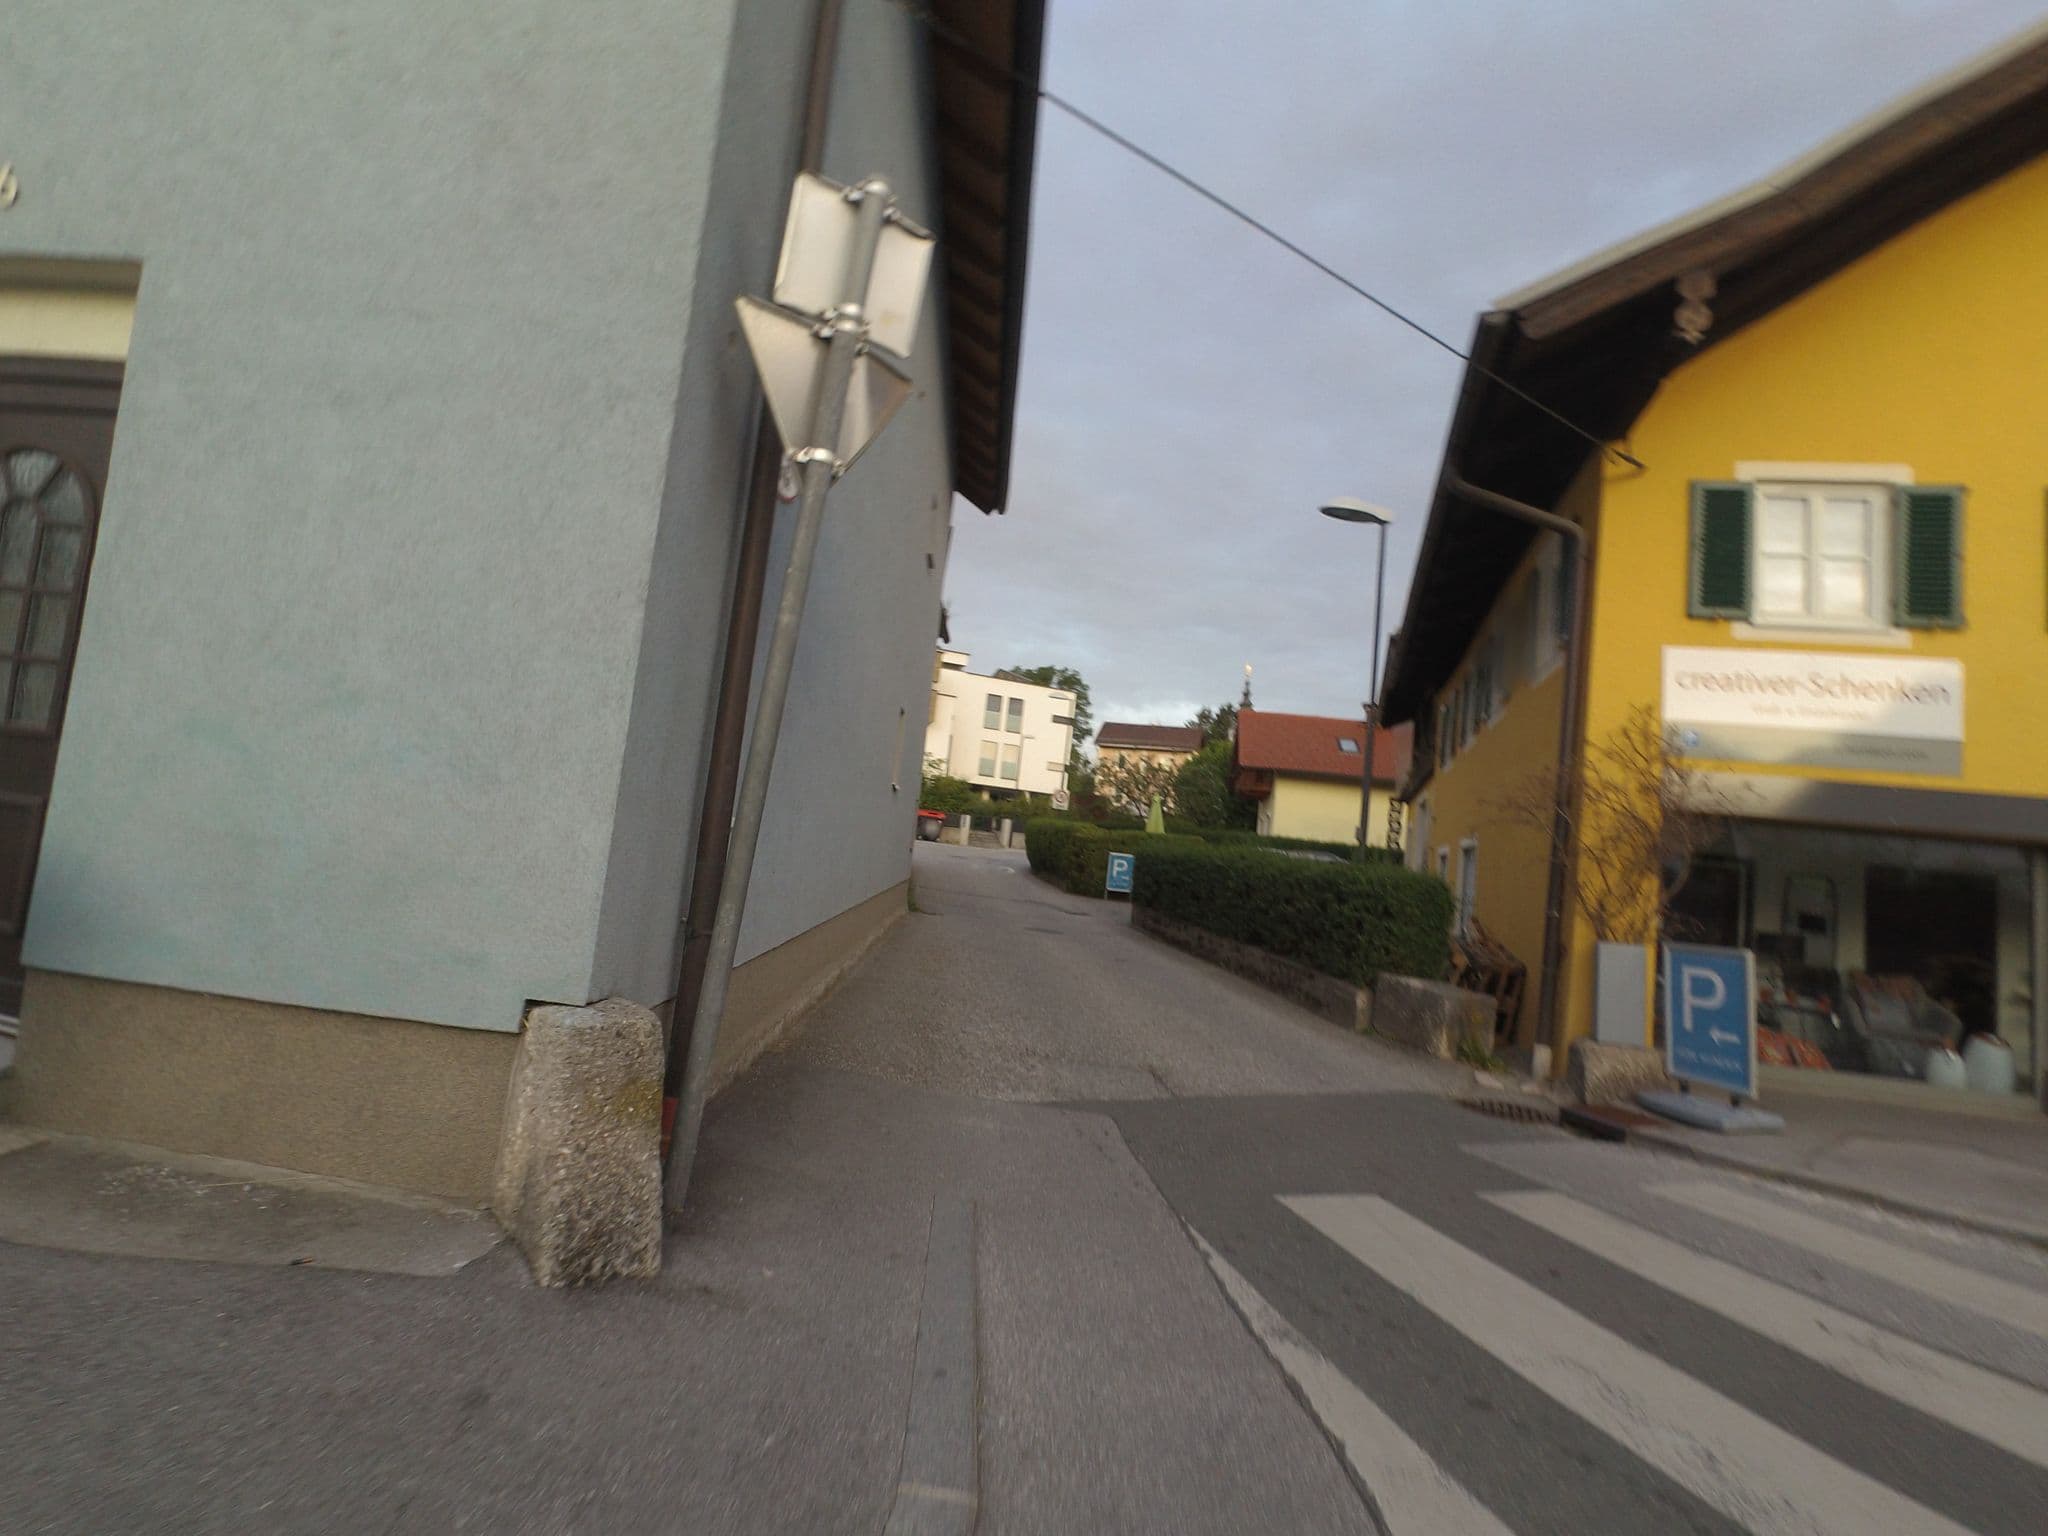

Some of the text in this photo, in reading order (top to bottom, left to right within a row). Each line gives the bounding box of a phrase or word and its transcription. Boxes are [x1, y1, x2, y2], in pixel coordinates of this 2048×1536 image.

[1807, 671, 1952, 704] Schenken
[1113, 860, 1129, 878] P
[1682, 967, 1726, 1031] P
